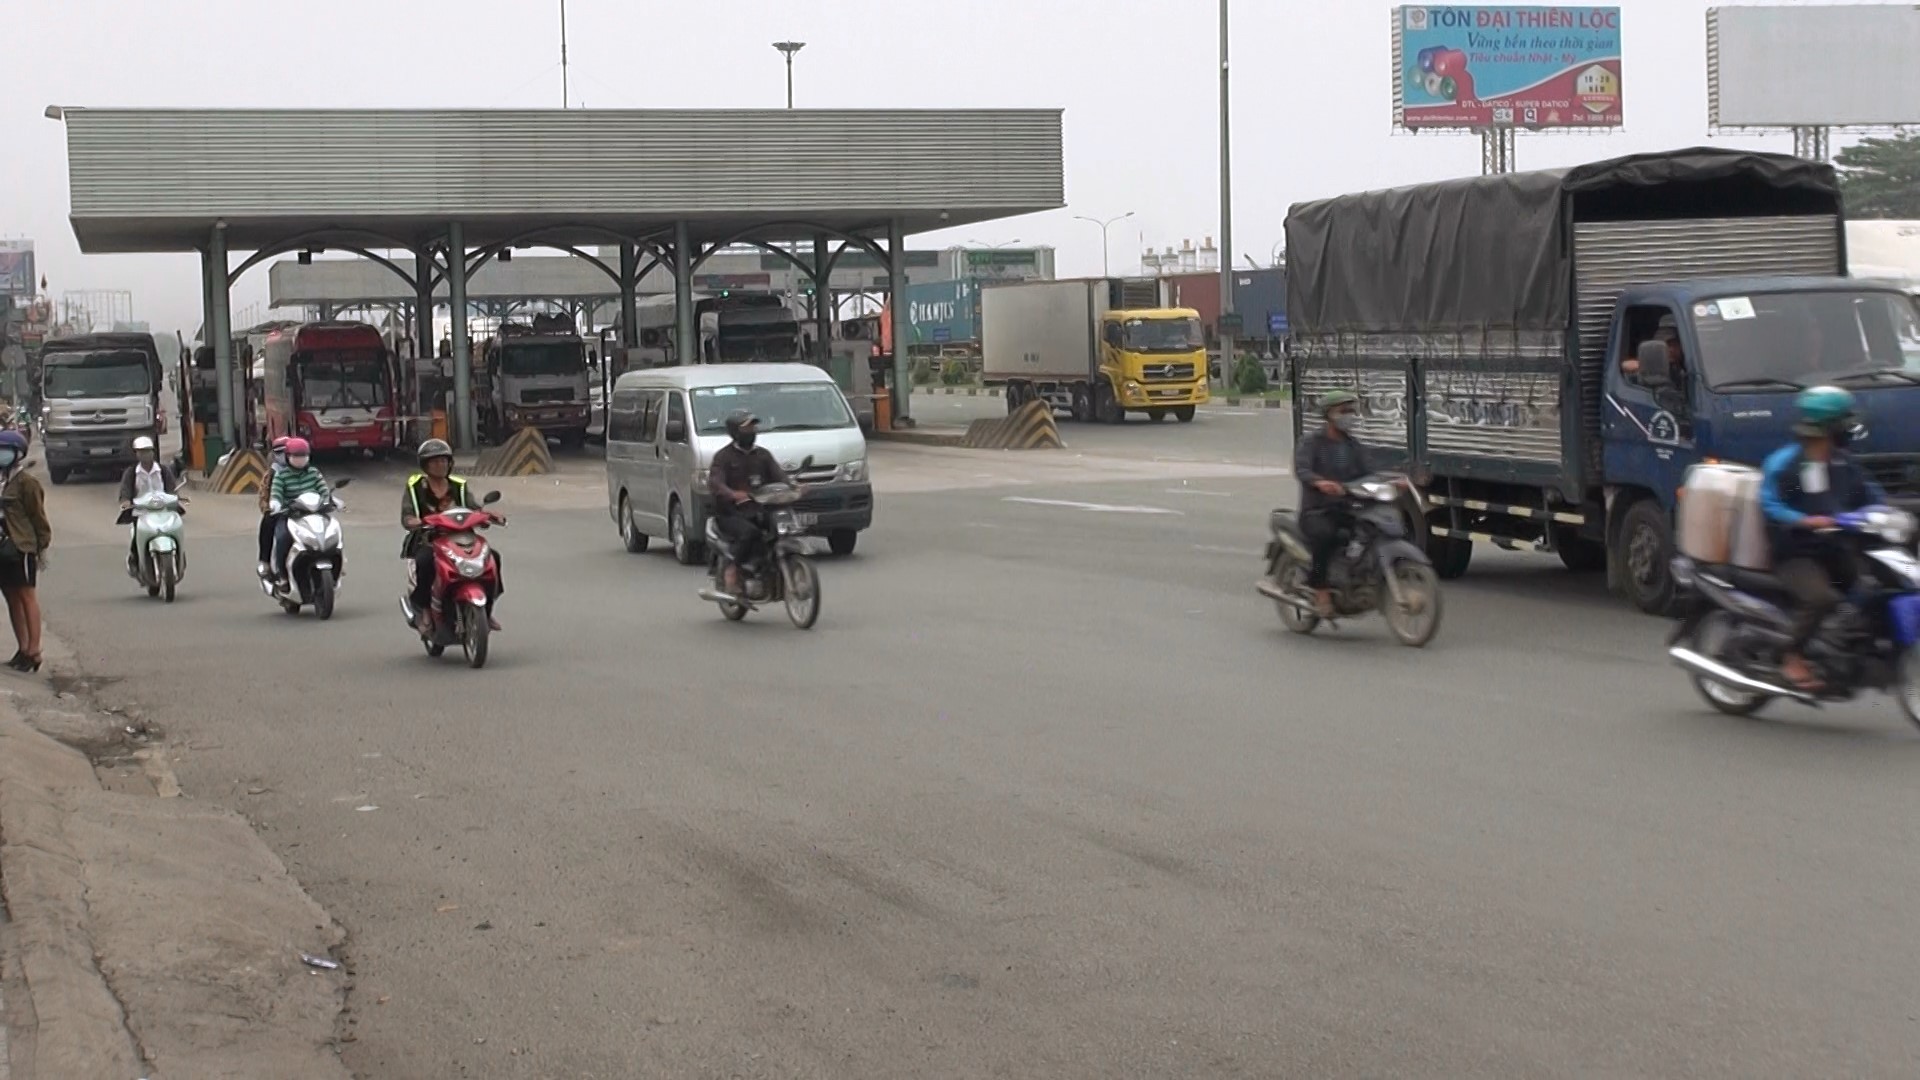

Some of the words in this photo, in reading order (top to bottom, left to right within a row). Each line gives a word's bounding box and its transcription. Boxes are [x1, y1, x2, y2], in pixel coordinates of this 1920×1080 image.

[1430, 7, 1471, 28] TÔN
[1476, 11, 1511, 32] ĐẠI
[1516, 8, 1573, 28] THIÊN
[1579, 9, 1617, 33] LỘC
[1530, 36, 1557, 49] theo
[1585, 36, 1614, 52] gian
